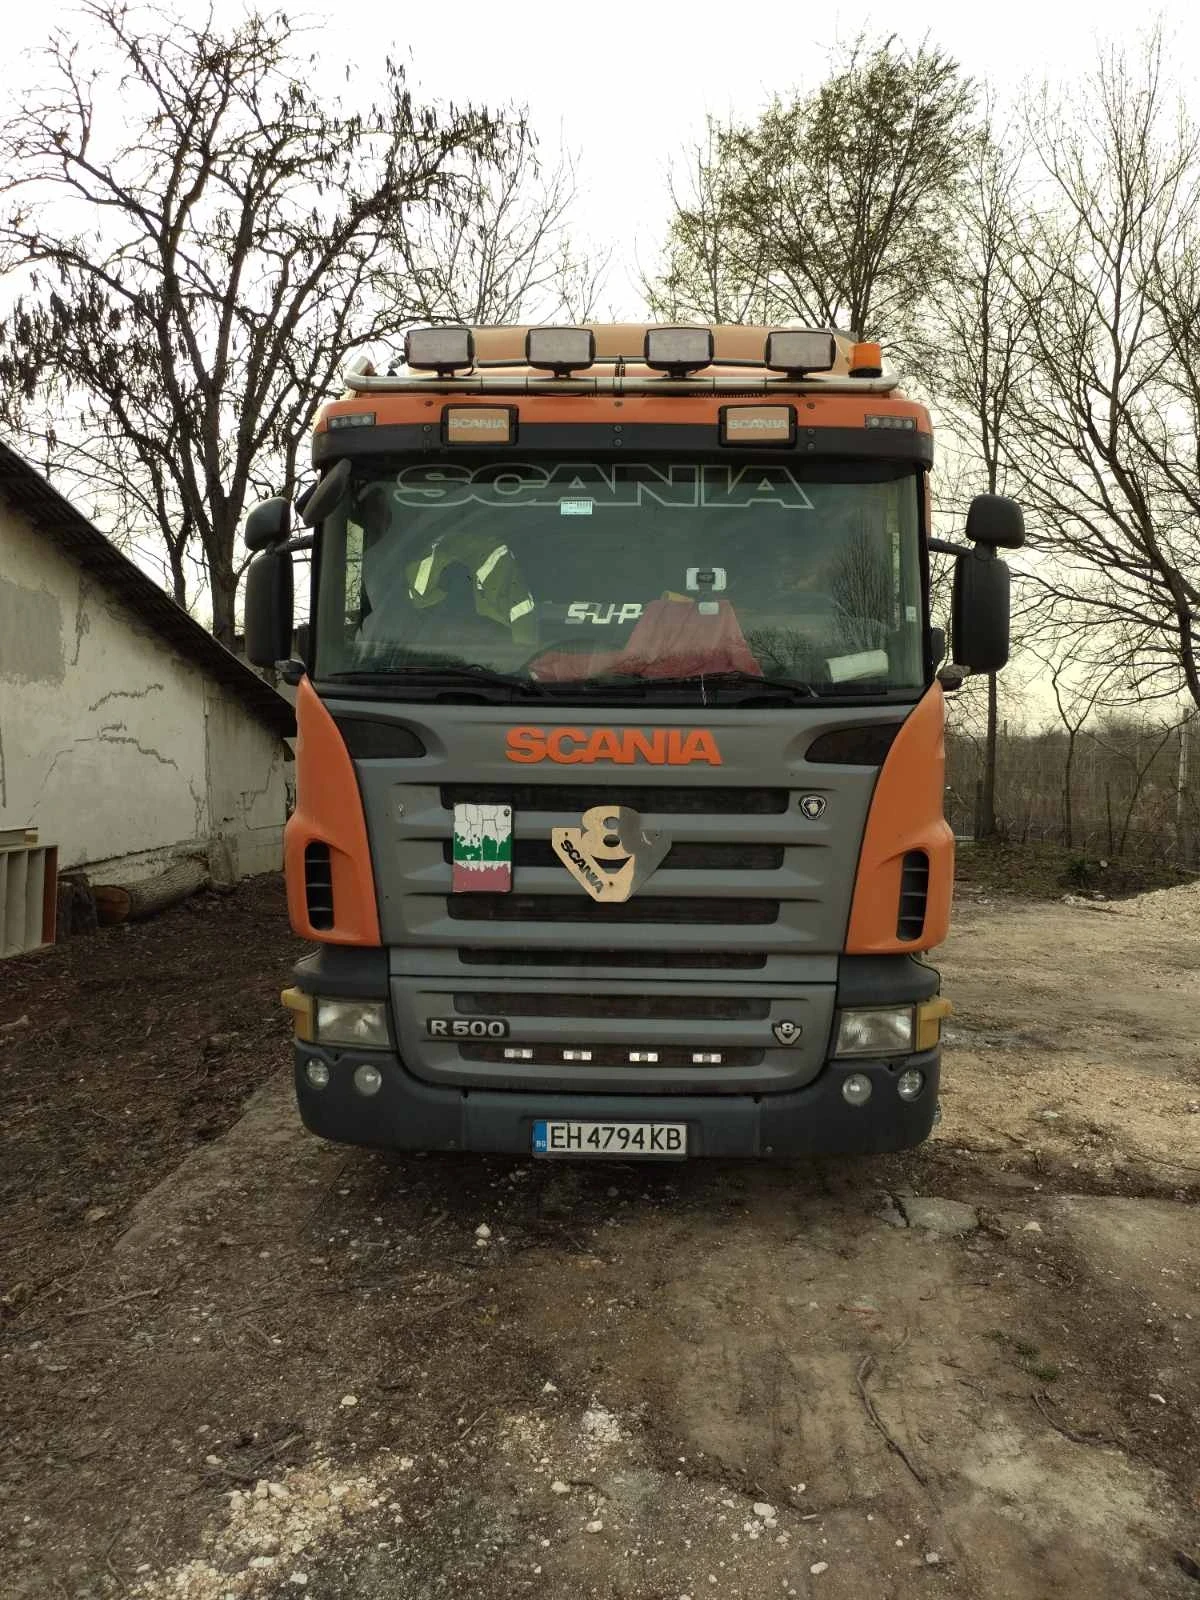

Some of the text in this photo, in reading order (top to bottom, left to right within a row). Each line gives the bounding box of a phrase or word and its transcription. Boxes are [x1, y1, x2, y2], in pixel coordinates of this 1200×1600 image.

[448, 418, 509, 430] SCANIA
[727, 417, 787, 430] SCANIA
[393, 463, 816, 510] SCANIA
[564, 601, 643, 625] SUP
[505, 726, 723, 766] SCANIA
[560, 839, 605, 895] SCANIA
